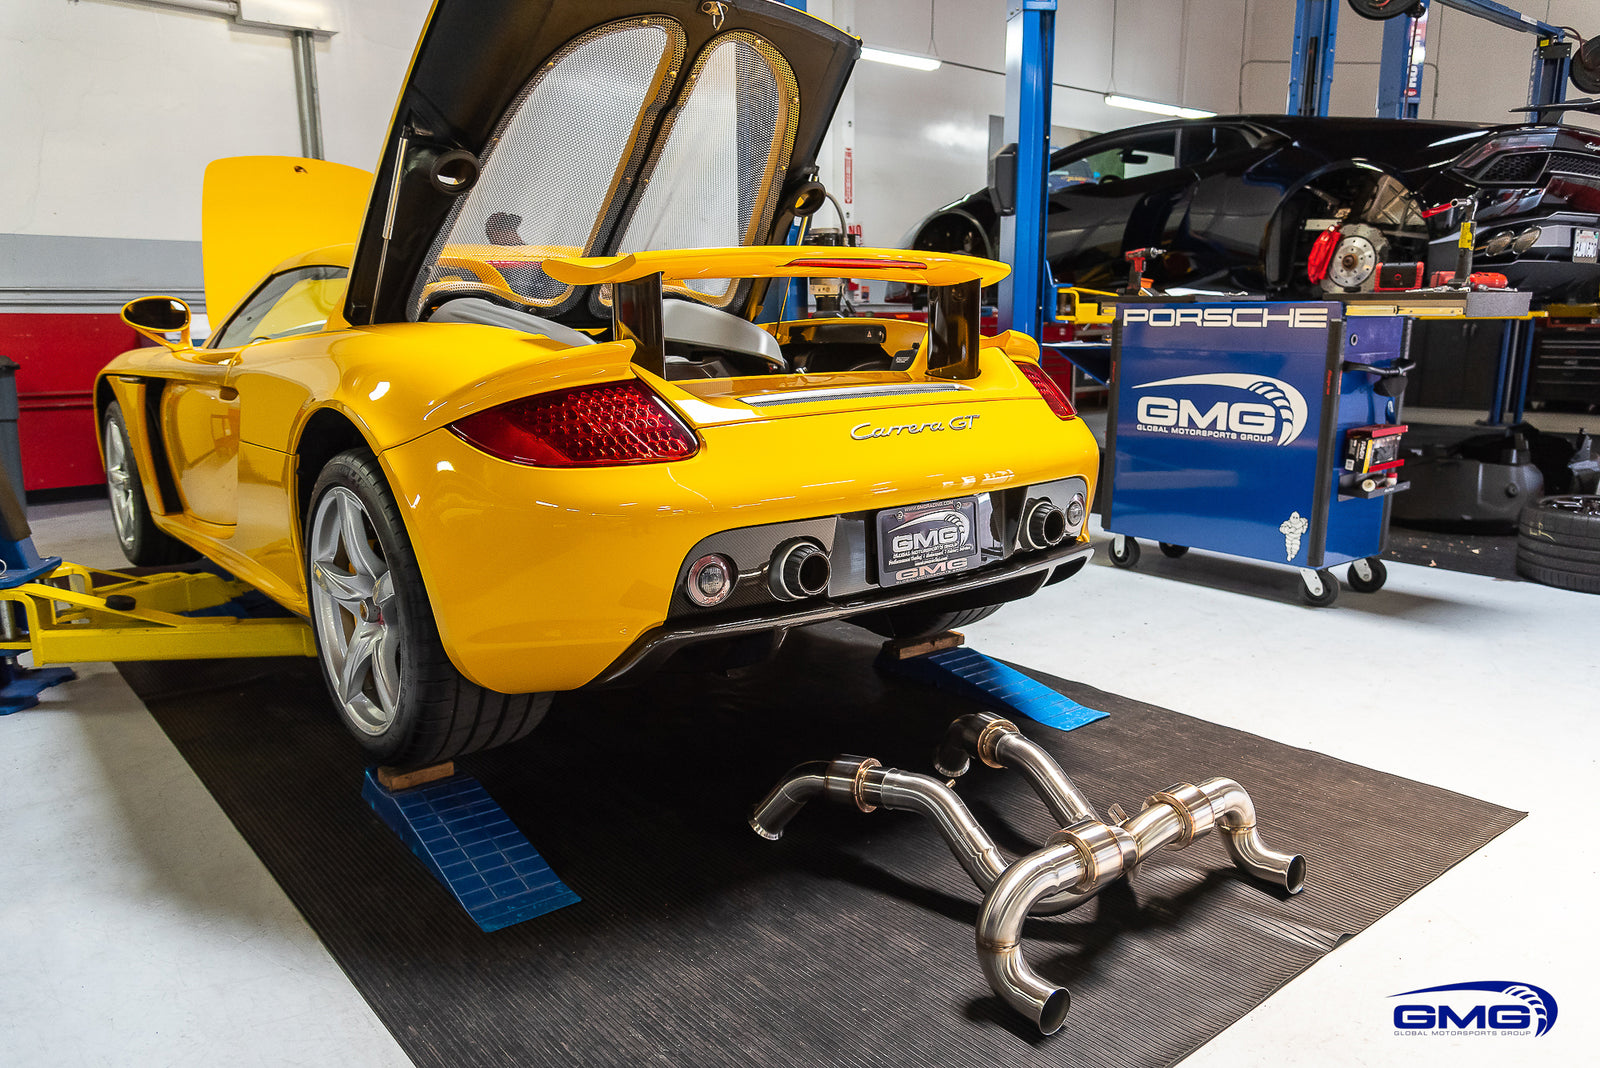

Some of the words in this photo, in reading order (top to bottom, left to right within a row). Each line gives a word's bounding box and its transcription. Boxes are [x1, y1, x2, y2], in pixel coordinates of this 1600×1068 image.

[1122, 307, 1329, 328] PORSCHE
[850, 422, 945, 441] Carrera
[948, 414, 980, 430] GT
[1136, 395, 1276, 435] GMG
[1136, 423, 1169, 435] GLOBAL
[1171, 426, 1238, 440] MOTORSPORTS
[1240, 432, 1274, 443] GROUP
[892, 526, 958, 552] GMG
[895, 557, 968, 581] GMG
